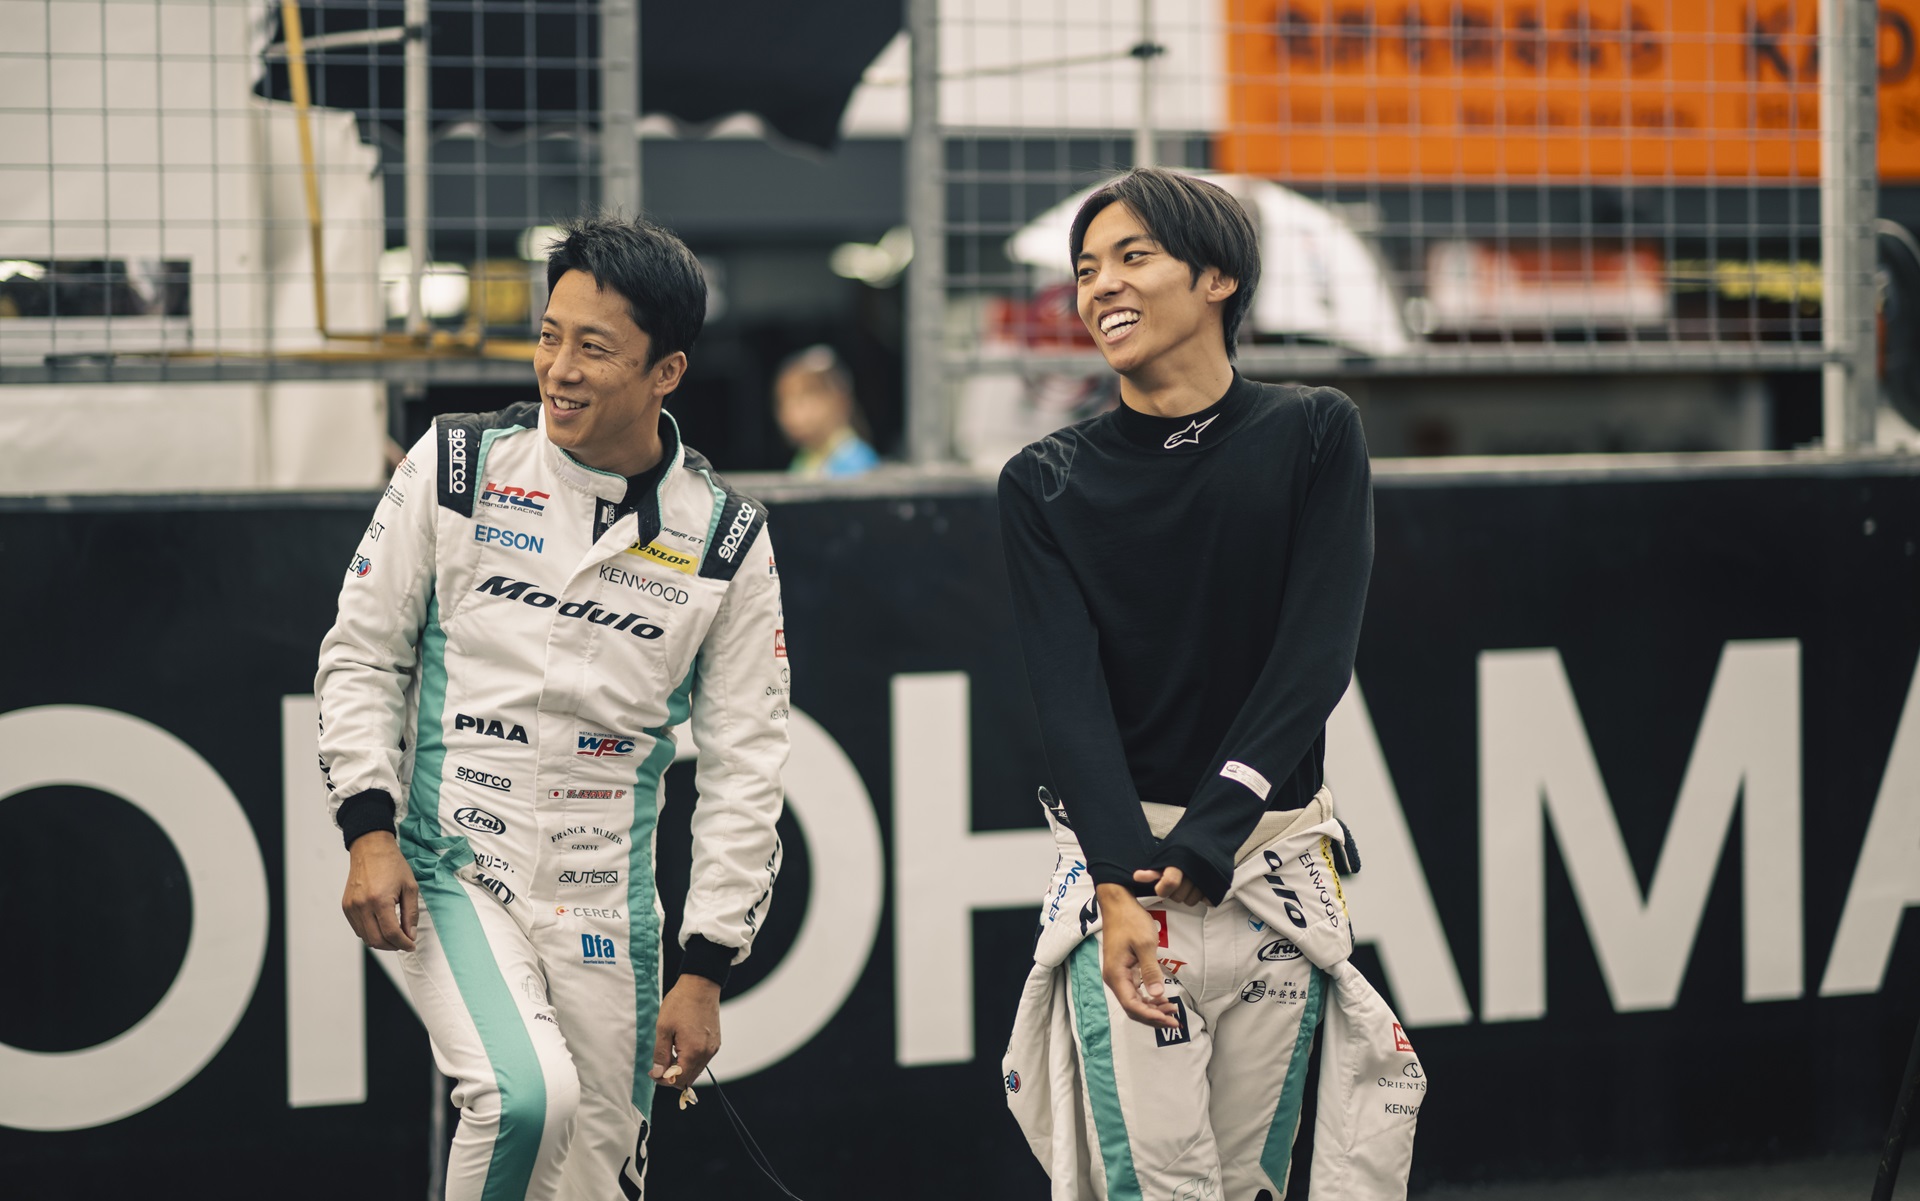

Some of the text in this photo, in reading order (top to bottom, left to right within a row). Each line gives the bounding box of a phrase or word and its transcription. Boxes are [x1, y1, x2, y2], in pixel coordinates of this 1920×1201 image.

[448, 429, 467, 494] sparco
[479, 500, 543, 517] Honda RACING
[481, 482, 550, 511] HRC
[475, 524, 544, 554] EPSON
[688, 536, 705, 544] GT
[718, 502, 757, 562] sparco
[599, 564, 689, 605] KENWOOD
[475, 575, 665, 640] Modulo
[455, 713, 529, 744] PIAA
[455, 766, 512, 792] sparco
[458, 810, 501, 831] Arai
[551, 826, 623, 845] FRANCK MULLER
[1299, 849, 1339, 928] ENWOOD
[573, 907, 622, 920] CEREA
[581, 934, 615, 958] Dfa
